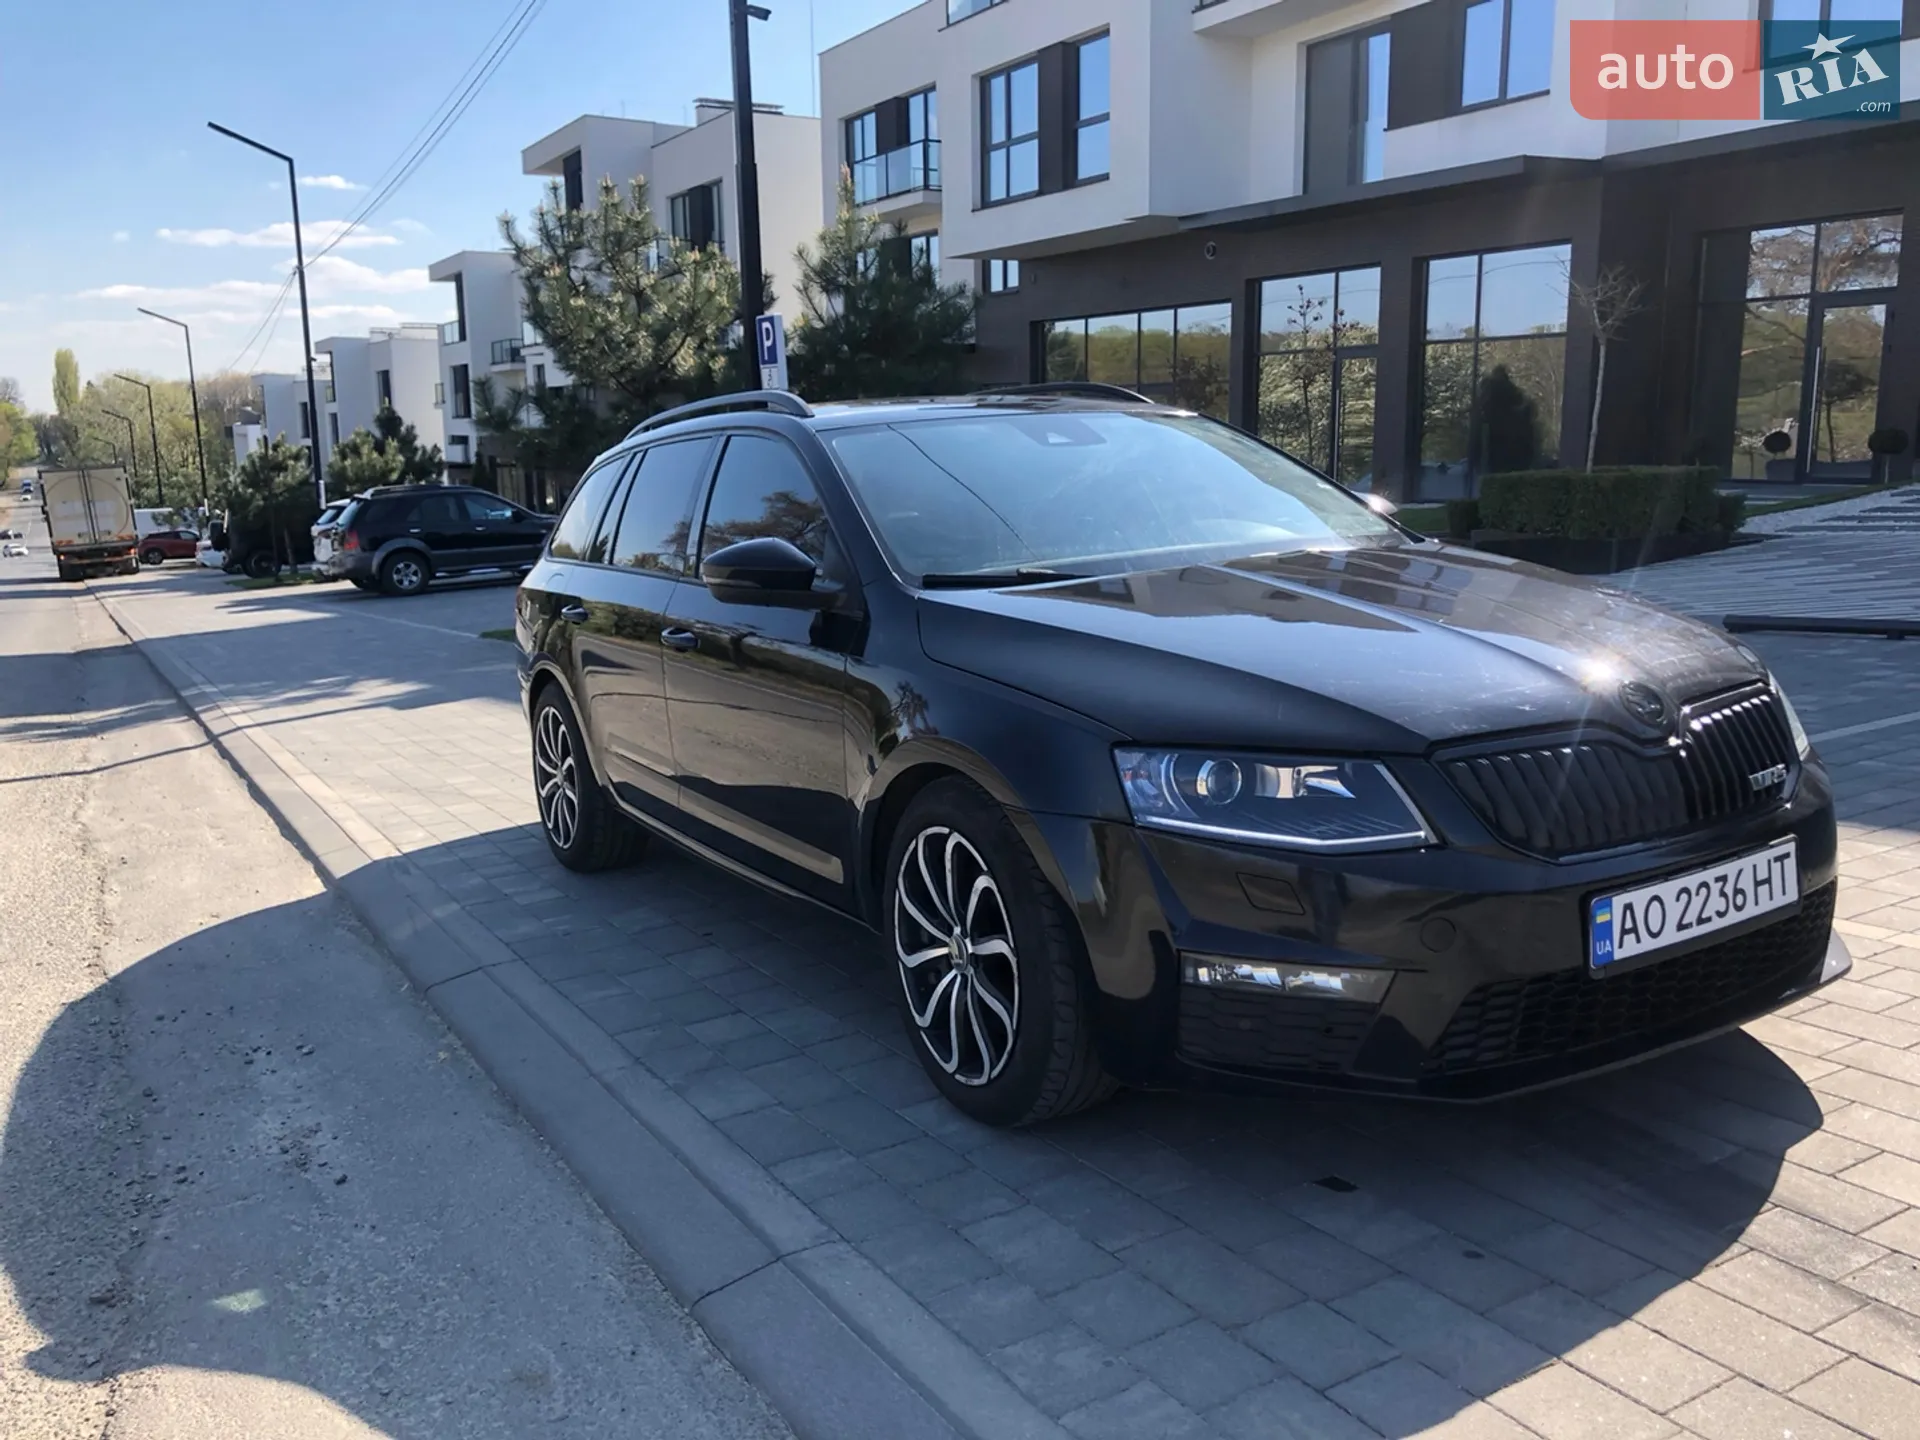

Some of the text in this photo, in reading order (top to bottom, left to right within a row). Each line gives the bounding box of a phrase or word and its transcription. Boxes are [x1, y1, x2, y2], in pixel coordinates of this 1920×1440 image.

[761, 321, 774, 361] P
[1617, 851, 1791, 950] AO 2236 HT
[1596, 939, 1613, 955] UA
